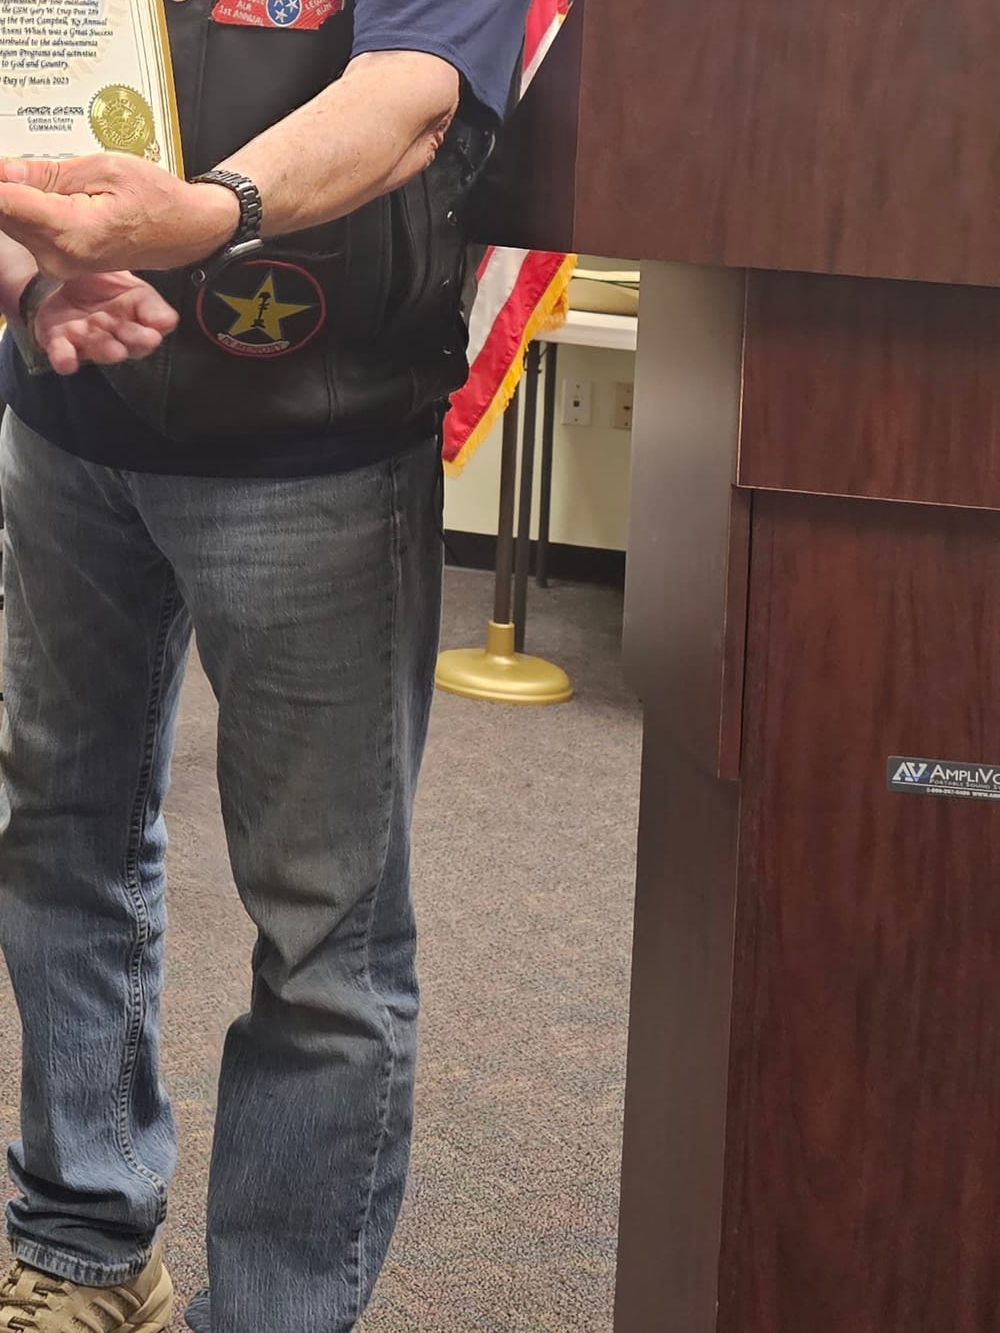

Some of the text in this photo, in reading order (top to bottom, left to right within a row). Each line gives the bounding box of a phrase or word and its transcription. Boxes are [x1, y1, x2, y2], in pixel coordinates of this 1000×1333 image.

[6, 16, 19, 25] the
[82, 17, 108, 27] Annual
[69, 27, 89, 38] Great
[89, 28, 114, 37] Success
[40, 37, 51, 46] the
[19, 48, 51, 59] Programs
[51, 48, 66, 57] and
[1, 60, 11, 69] to
[10, 58, 26, 70] God
[25, 58, 41, 69] and
[2, 76, 18, 88] Day
[18, 75, 27, 88] of
[28, 76, 51, 87] March
